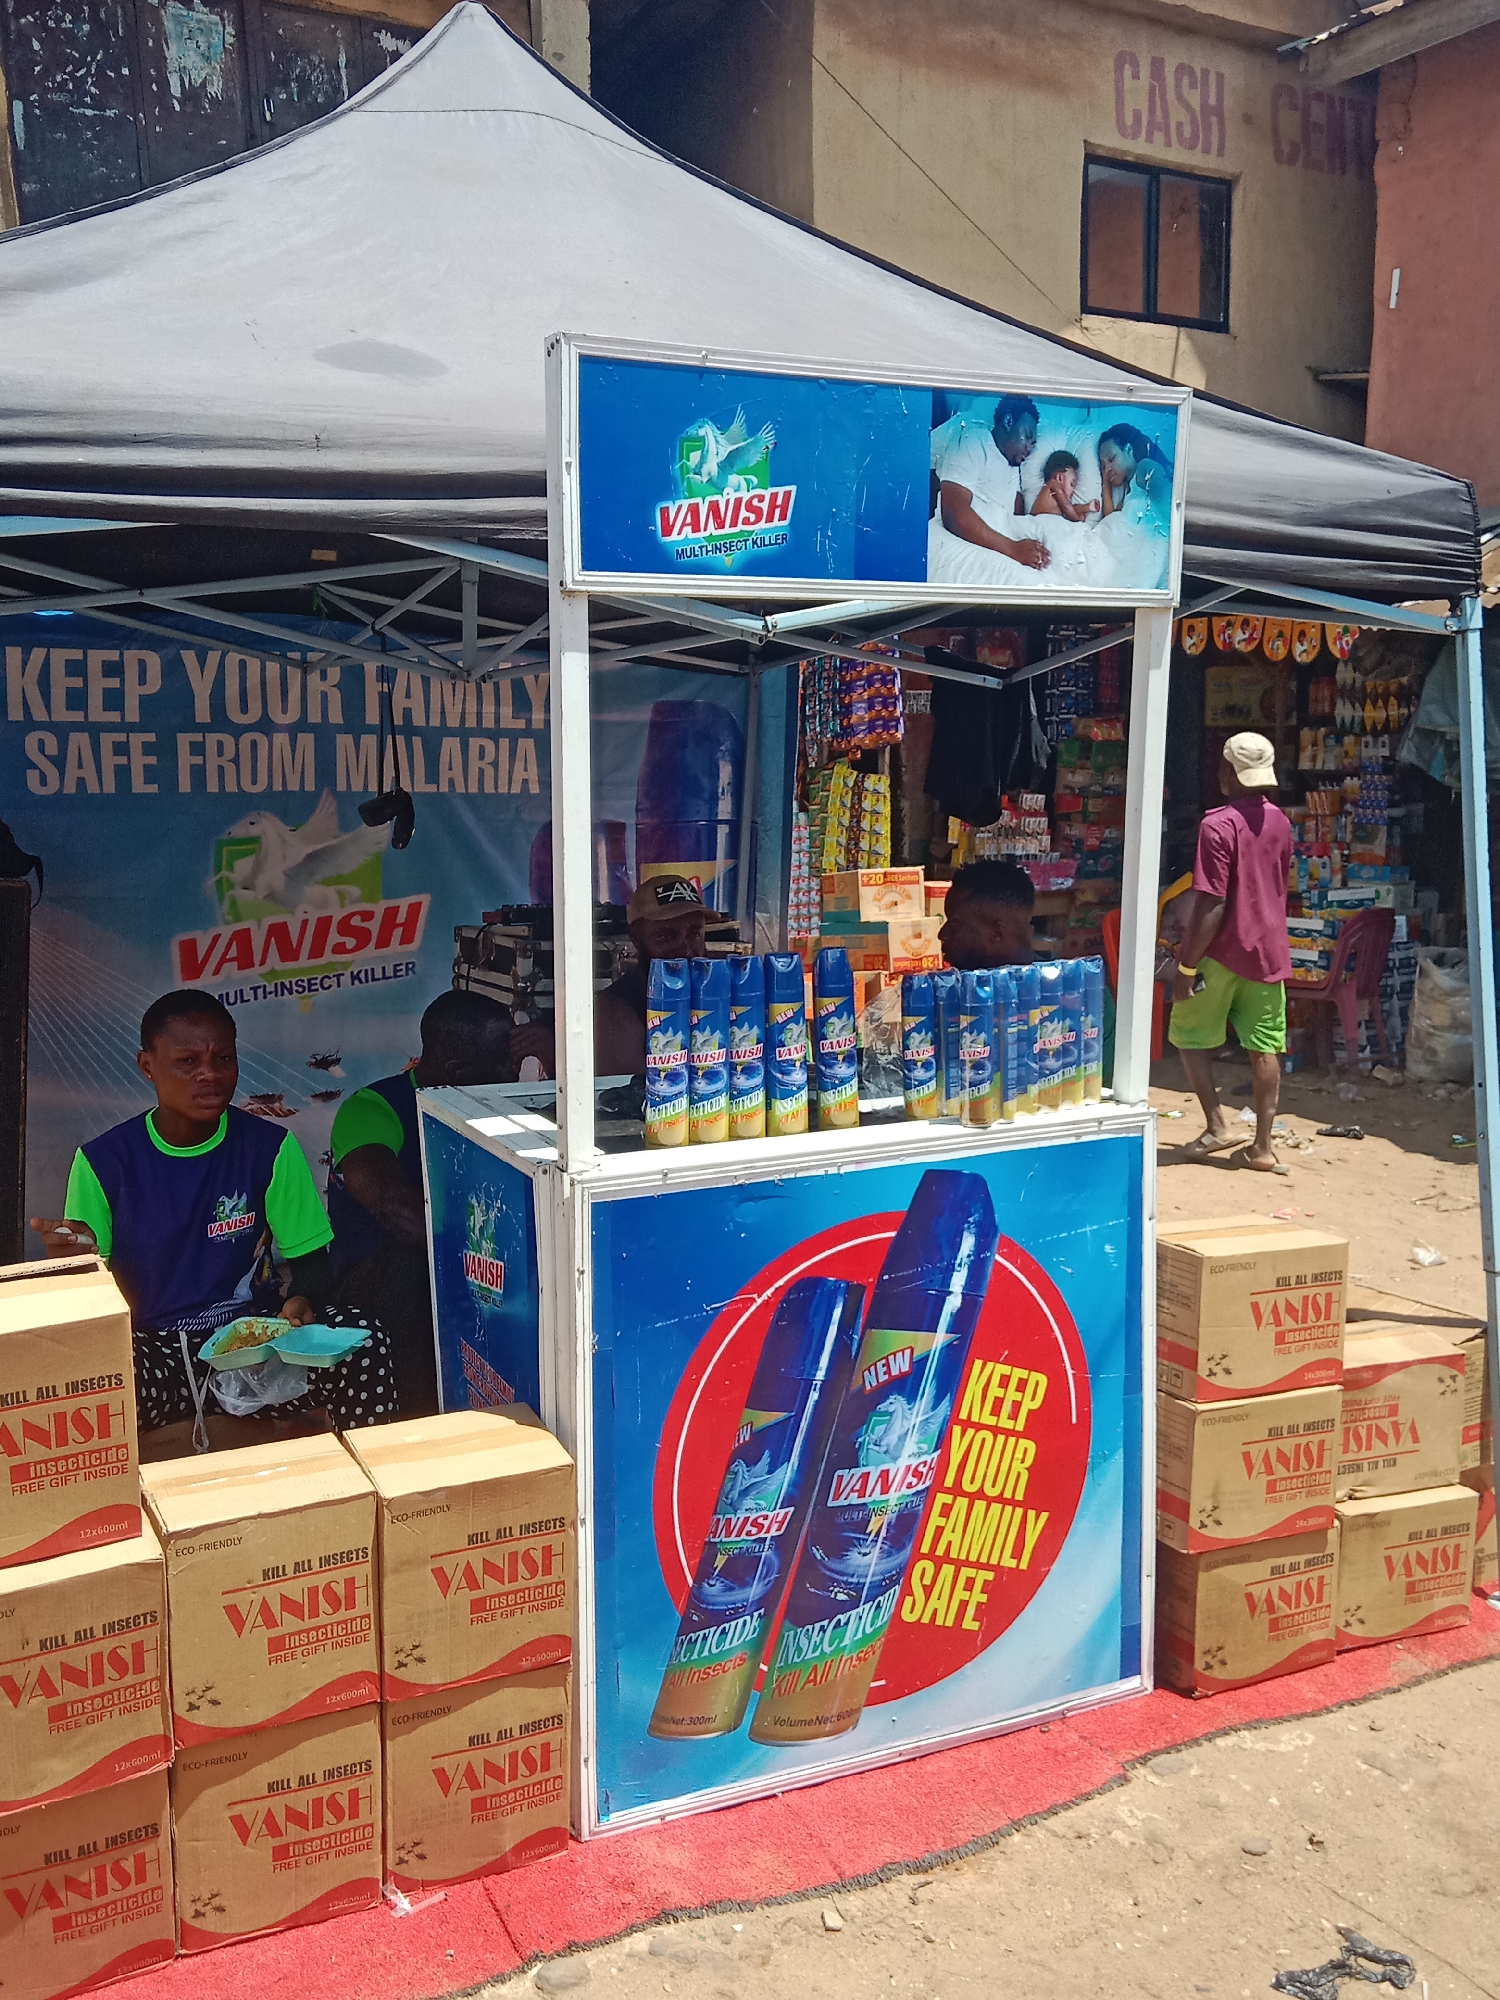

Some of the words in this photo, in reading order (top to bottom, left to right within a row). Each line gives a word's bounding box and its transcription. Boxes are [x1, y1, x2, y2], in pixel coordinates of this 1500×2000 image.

[1113, 50, 1226, 157] CASH
[660, 489, 792, 538] VANISH
[752, 533, 788, 549] KILLER
[4, 646, 162, 723] KEEP
[180, 650, 345, 725] YOUR
[364, 656, 551, 730] FAMILY
[24, 730, 158, 796] SAFE
[176, 733, 316, 794] FROM
[335, 733, 541, 794] MALARIA
[178, 901, 423, 983] VANISH
[350, 961, 418, 986] KILLER
[208, 1213, 254, 1237] VANISH
[463, 1250, 503, 1291] VANISH
[1276, 1275, 1291, 1288] KILL
[1295, 1274, 1308, 1286] ALL
[1311, 1270, 1343, 1284] INSECTS
[1250, 1290, 1342, 1332] VANISH
[863, 1348, 912, 1391] NEW
[0, 1390, 30, 1407] KILL
[36, 1385, 59, 1401] ALL
[65, 1373, 124, 1395] INSECTS
[960, 1358, 1048, 1431] KEEP
[1267, 1426, 1283, 1438] KILL
[1287, 1424, 1301, 1435] ALL
[1303, 1418, 1336, 1433] INSECTS
[30, 1447, 128, 1479] insecticide
[944, 1430, 1037, 1501] YOUR
[1241, 1438, 1334, 1481] VANISH
[11, 1480, 46, 1496] FREE
[50, 1473, 80, 1489] GIFT
[84, 1463, 129, 1482] INSIDE
[832, 1455, 938, 1502] VANISH
[80, 1521, 129, 1539] 12x600ml
[391, 1504, 451, 1524] ECO-FRIENDLY
[175, 1537, 243, 1557] ECO-FRIENDLY
[467, 1531, 491, 1547] KILL
[495, 1526, 514, 1540] ALL
[519, 1517, 565, 1536] INSECTS
[920, 1494, 1049, 1571] FAMILY
[262, 1564, 288, 1581] KILL
[293, 1559, 313, 1575] ALL
[318, 1546, 369, 1569] INSECTS
[430, 1542, 565, 1600] VANISH
[1270, 1564, 1286, 1577] KILL
[1289, 1562, 1301, 1572] ALL
[1303, 1553, 1335, 1569] INSECTS
[1383, 1543, 1469, 1582] VANISH
[222, 1573, 369, 1639] VANISH
[470, 1611, 498, 1626] FREE
[501, 1606, 526, 1619] GIFT
[528, 1598, 564, 1614] INSIDE
[486, 1582, 565, 1610] insecticide
[901, 1559, 995, 1632] SAFE
[1244, 1574, 1332, 1621] VANISH
[39, 1634, 67, 1651] KILL
[74, 1626, 96, 1643] ALL
[102, 1610, 158, 1636] INSECTS
[285, 1617, 370, 1649] insecticide
[269, 1650, 298, 1666] FREE
[301, 1643, 328, 1658] GIFT
[331, 1633, 370, 1651] INSIDE
[521, 1648, 562, 1665] 12x600ml
[0, 1635, 159, 1709] VANISH
[686, 1652, 749, 1687] Insects
[771, 1668, 802, 1699] Kill
[801, 1658, 834, 1691] All
[66, 1679, 160, 1716] insecticide
[325, 1686, 369, 1705] 12x600ml
[49, 1719, 82, 1735] FREE
[86, 1710, 115, 1726] GIFT
[119, 1694, 161, 1716] INSIDE
[391, 1705, 452, 1726] ECO-FRIENDLY
[469, 1733, 491, 1747] KILL
[497, 1727, 515, 1742] ALL
[520, 1714, 563, 1735] INSECTS
[114, 1750, 161, 1772] 12x600ml
[183, 1751, 248, 1771] ECO-FRIENDLY
[267, 1778, 292, 1794] KILL
[298, 1773, 317, 1788] ALL
[323, 1760, 372, 1782] INSECTS
[431, 1738, 563, 1799] VANISH
[229, 1784, 372, 1847] VANISH
[471, 1810, 498, 1824] FREE
[501, 1803, 525, 1818] GIFT
[527, 1792, 562, 1811] INSIDE
[43, 1849, 72, 1865] KILL
[78, 1841, 100, 1857] ALL
[105, 1823, 159, 1849] INSECTS
[272, 1859, 301, 1873] FREE
[305, 1852, 330, 1866] GIFT
[334, 1841, 373, 1860] INSIDE
[289, 1825, 374, 1857] insecticide
[3, 1847, 160, 1920] VANISH
[54, 1928, 87, 1944] FREE
[90, 1918, 117, 1934] GIFT
[121, 1903, 163, 1924] INSIDE
